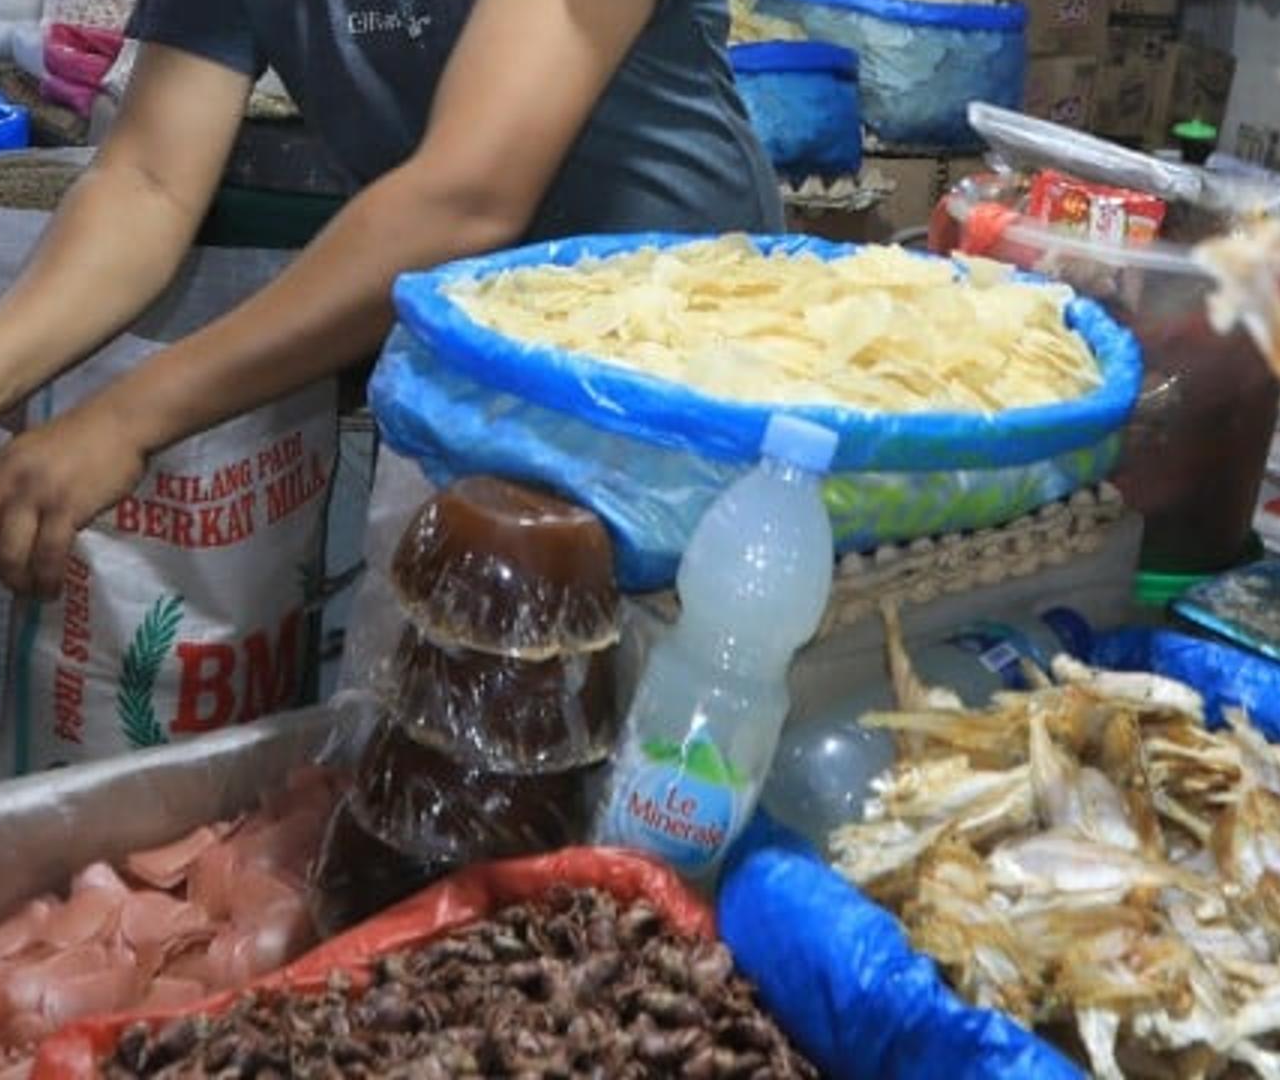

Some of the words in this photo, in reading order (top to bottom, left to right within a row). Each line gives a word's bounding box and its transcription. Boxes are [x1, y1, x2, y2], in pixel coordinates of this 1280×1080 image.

[116, 493, 256, 548] BERKAT
[266, 452, 326, 522] MILA
[155, 458, 253, 502] KILANG
[256, 433, 304, 481] PADI
[59, 557, 91, 665] BERAS
[51, 669, 90, 745] IR64
[169, 606, 307, 735] BM
[665, 786, 698, 817] Le
